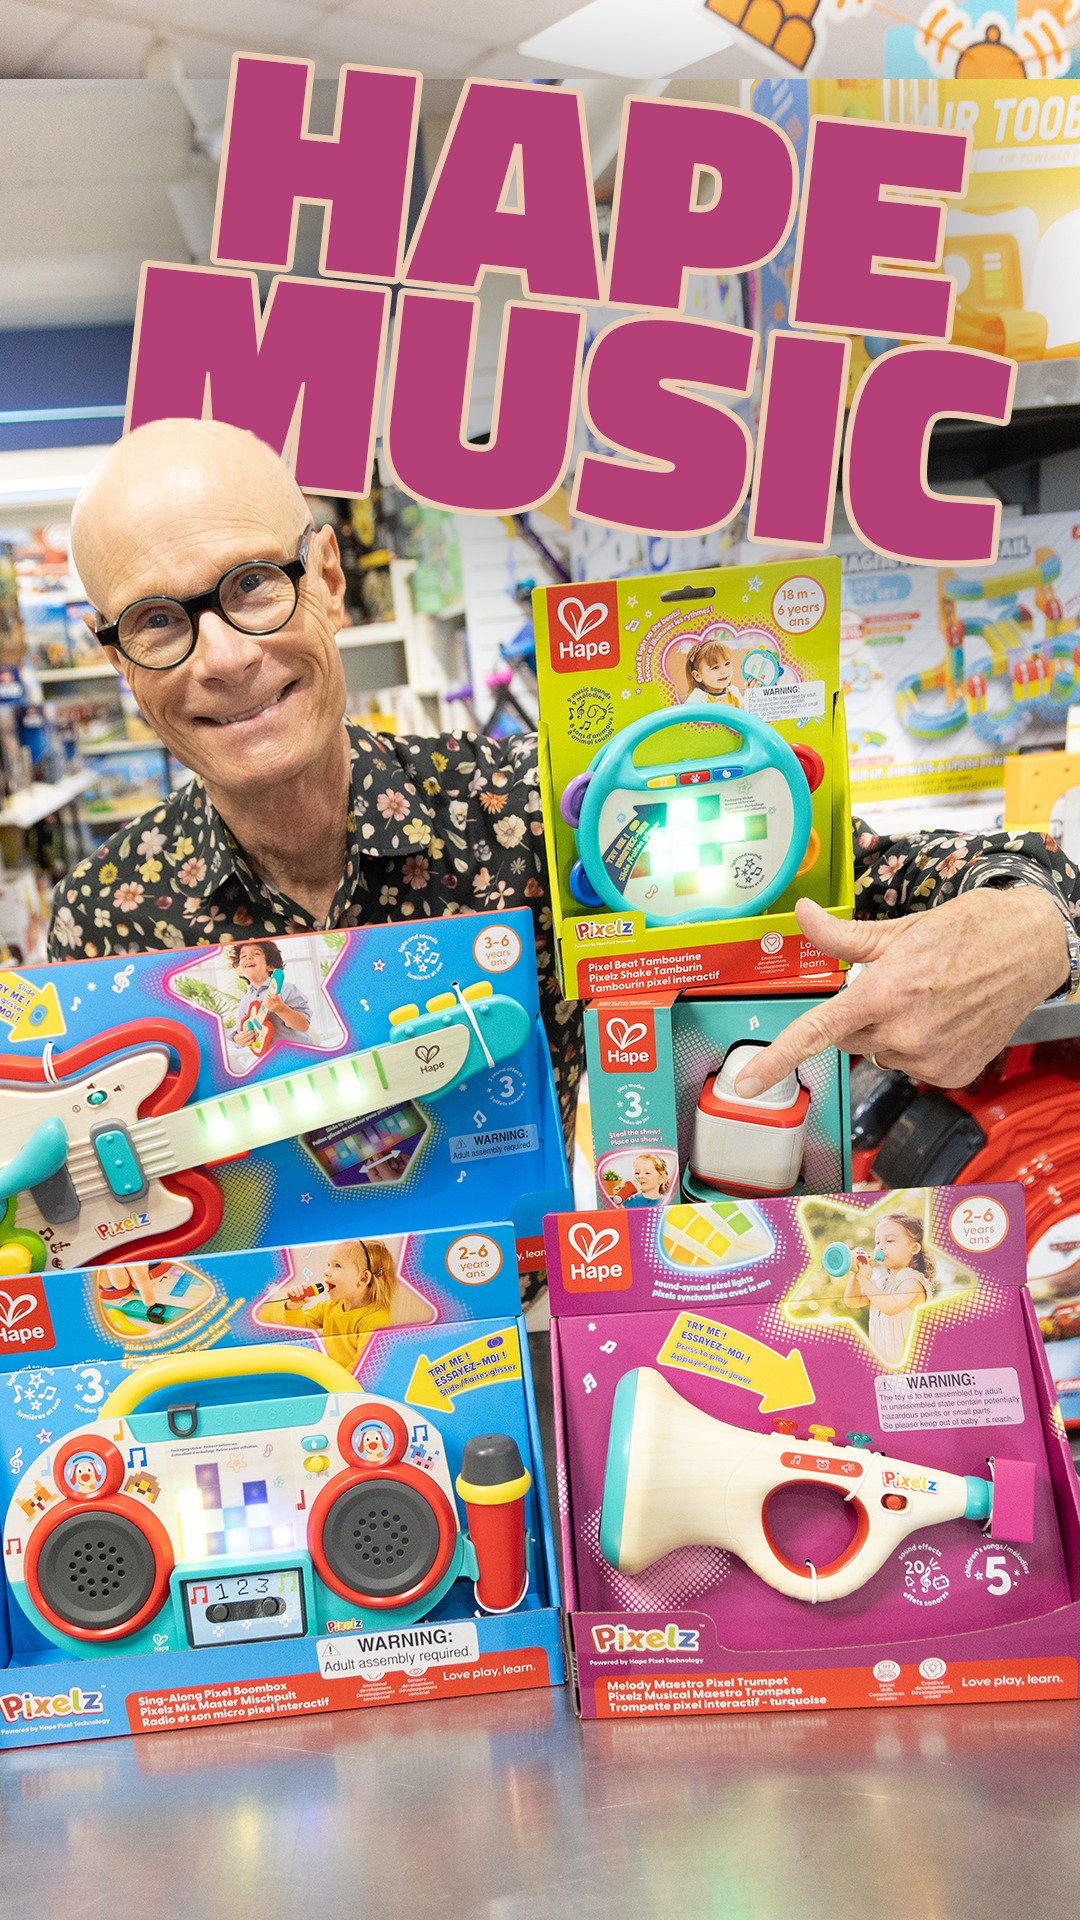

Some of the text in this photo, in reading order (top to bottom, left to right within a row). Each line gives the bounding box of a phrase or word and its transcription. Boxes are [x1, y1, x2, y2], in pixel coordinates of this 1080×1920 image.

[782, 589, 794, 600] 18
[797, 591, 807, 599] m
[777, 604, 820, 617] 6 years
[789, 617, 810, 627] ans
[559, 640, 610, 660] Hape
[763, 685, 800, 696] WARNING:
[576, 918, 634, 940] Pixelz
[484, 935, 510, 949] 3-6
[485, 949, 511, 960] years
[490, 958, 507, 967] ans
[588, 953, 701, 973] Pixel Beat Tambourine
[589, 963, 703, 983] Pixelz Shake Tamburin
[800, 960, 828, 969] learn.
[590, 970, 720, 993] Tambourin pixel interactif
[607, 1050, 649, 1065] Hape
[420, 1061, 445, 1075] Hape
[500, 1075, 515, 1098] 3
[624, 1091, 643, 1118] 3
[474, 1129, 529, 1146] WARNING:
[608, 1130, 627, 1139] Steal
[640, 1128, 661, 1136] show!
[610, 1138, 629, 1146] Place
[452, 1140, 533, 1160] Adult assembly required.
[963, 1207, 995, 1224] 2-6
[95, 1212, 151, 1240] Pixelz
[963, 1226, 995, 1237] years
[969, 1236, 990, 1244] ans
[458, 1244, 489, 1260] 2-6
[460, 1260, 490, 1272] years
[465, 1269, 485, 1278] ans
[570, 1264, 622, 1282] Hape
[651, 1279, 771, 1302] pixels synchronisés avec le son
[653, 1276, 754, 1293] sound-synced pixel lights
[686, 1320, 721, 1337] TRY ME
[676, 1342, 729, 1366] Press to play
[681, 1330, 745, 1361] ESSAYEZ-MOI
[428, 1354, 464, 1378] TRY ME
[434, 1353, 500, 1388] ESSAYEZ-MOI
[670, 1352, 752, 1385] Appuyez pour jouer
[80, 1368, 105, 1404] 3
[906, 1373, 976, 1389] WARNING:
[889, 1401, 936, 1410] unassembled
[956, 1398, 982, 1406] contain
[984, 1396, 1020, 1406] potentially
[895, 1394, 905, 1402] toy
[934, 1389, 973, 1398] assembled
[974, 1389, 983, 1397] by
[881, 1412, 919, 1420] hazardous
[920, 1410, 941, 1419] points
[952, 1408, 971, 1416] small
[883, 1422, 893, 1430] So
[895, 1421, 918, 1430] please
[920, 1420, 938, 1428] keep
[882, 1470, 940, 1495] Pixelz
[898, 1543, 942, 1560] sound effects
[904, 1560, 925, 1575] 20
[985, 1556, 1012, 1596] 5
[215, 1578, 270, 1600] 1 2 3
[902, 1590, 949, 1606] effets sonores
[326, 1618, 363, 1632] Pixelz
[358, 1629, 453, 1653] WARNING:
[591, 1624, 699, 1652] Pixelz
[324, 1645, 473, 1673] Adult assembly required.
[619, 1658, 629, 1666] by
[665, 1657, 704, 1665] Technology
[443, 1662, 536, 1681] Love play, learn.
[607, 1676, 788, 1691] Melody Maestro Pixel Trumpet
[962, 1673, 1063, 1688] Love play, learn.
[138, 1682, 287, 1707] Sing-Along Pixel Boombox
[608, 1687, 803, 1701] Pixelz Musical Maestro Trompete
[0, 1687, 103, 1722] Pixelz
[140, 1691, 297, 1717] Pixelz Mix Master Mischpult
[142, 1697, 330, 1727] Radio et son micro pixel interactif
[609, 1701, 671, 1713] Trompette
[673, 1699, 702, 1712] pixel
[704, 1697, 760, 1709] interactif
[770, 1695, 828, 1707] turquoise
